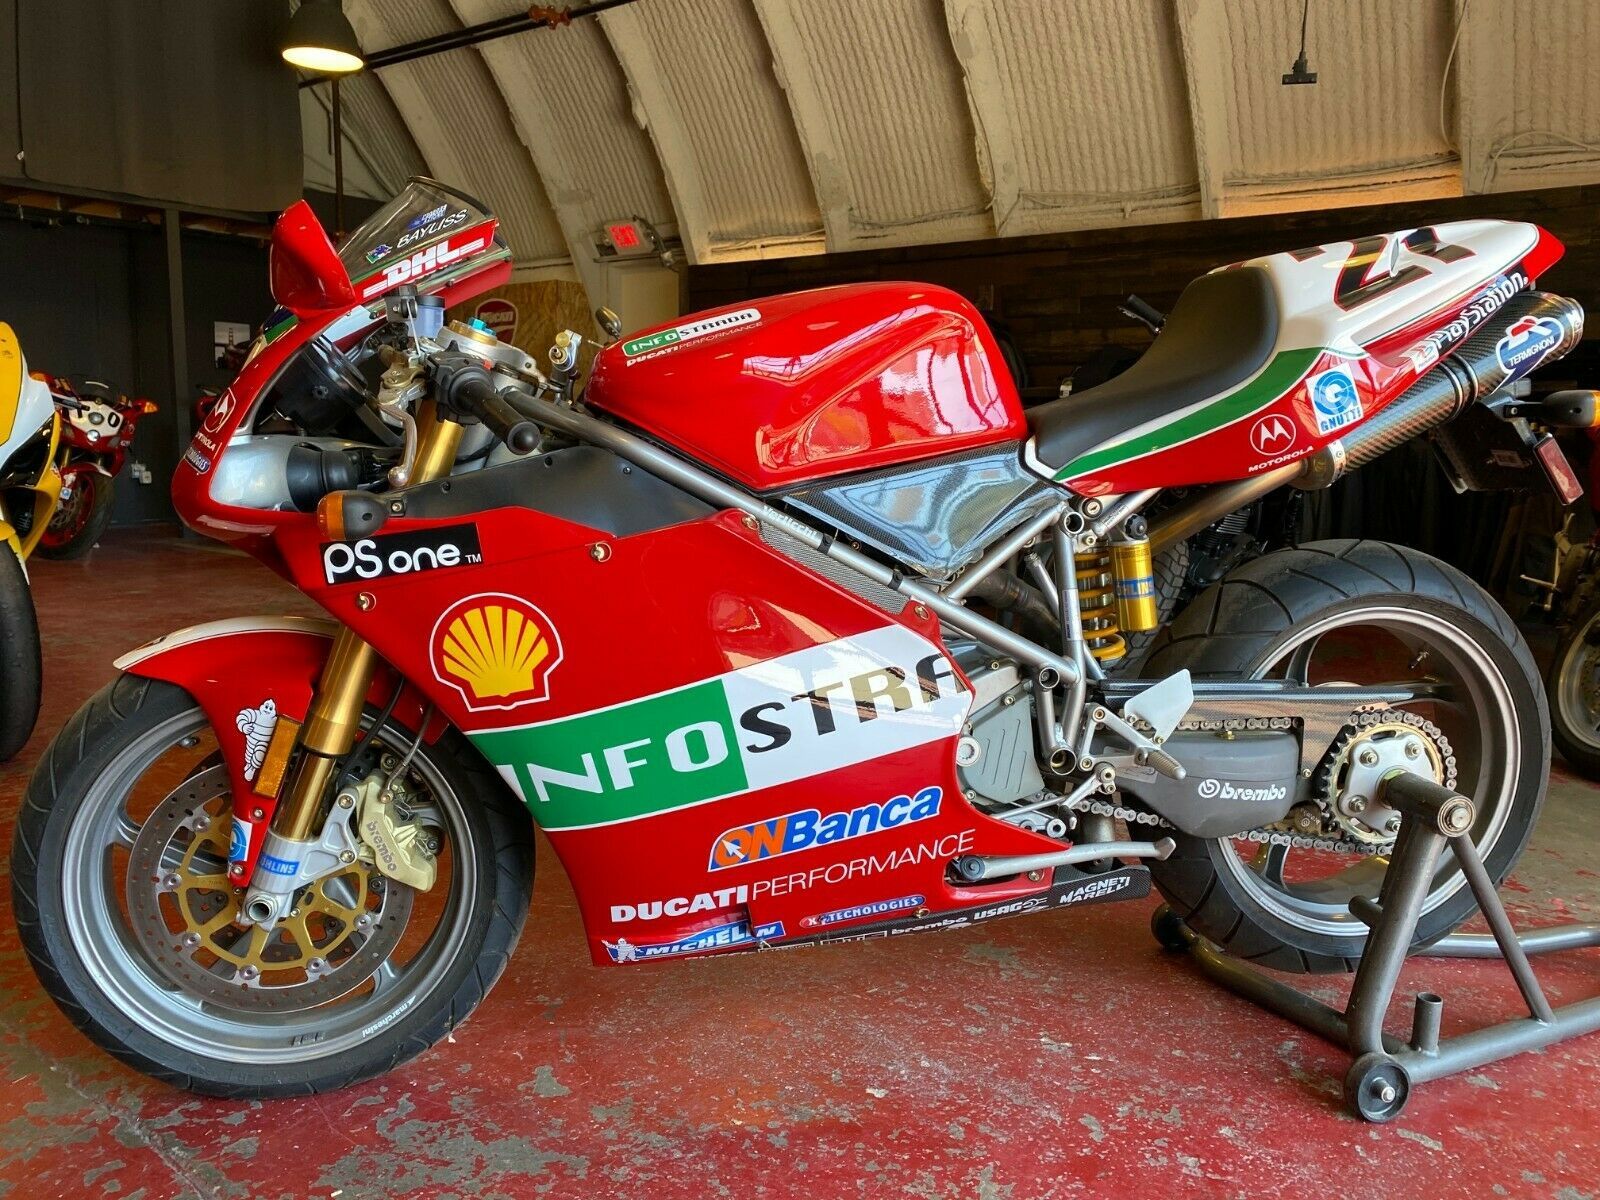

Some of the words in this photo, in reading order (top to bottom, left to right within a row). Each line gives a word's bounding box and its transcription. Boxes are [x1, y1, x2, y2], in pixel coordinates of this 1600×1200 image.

[397, 209, 468, 248] BAYLISS
[382, 240, 460, 287] DHL
[626, 345, 680, 367] DUCATI
[678, 320, 764, 350] PERFORMANCE
[630, 311, 754, 352] INFOSTRADA
[1509, 335, 1556, 367] TERMIGNONI
[1320, 406, 1362, 432] GNUTTI
[1248, 445, 1314, 473] MOTOROLA
[324, 539, 383, 584] PS
[388, 543, 461, 573] one
[1220, 782, 1287, 801] brembo
[367, 820, 397, 871] brembo
[610, 885, 748, 923] DUCATI
[752, 829, 977, 900] PERFORMANCE
[1060, 876, 1131, 904] MAGNETI
[891, 916, 968, 935] brembo
[362, 1002, 408, 1038] marchesini
